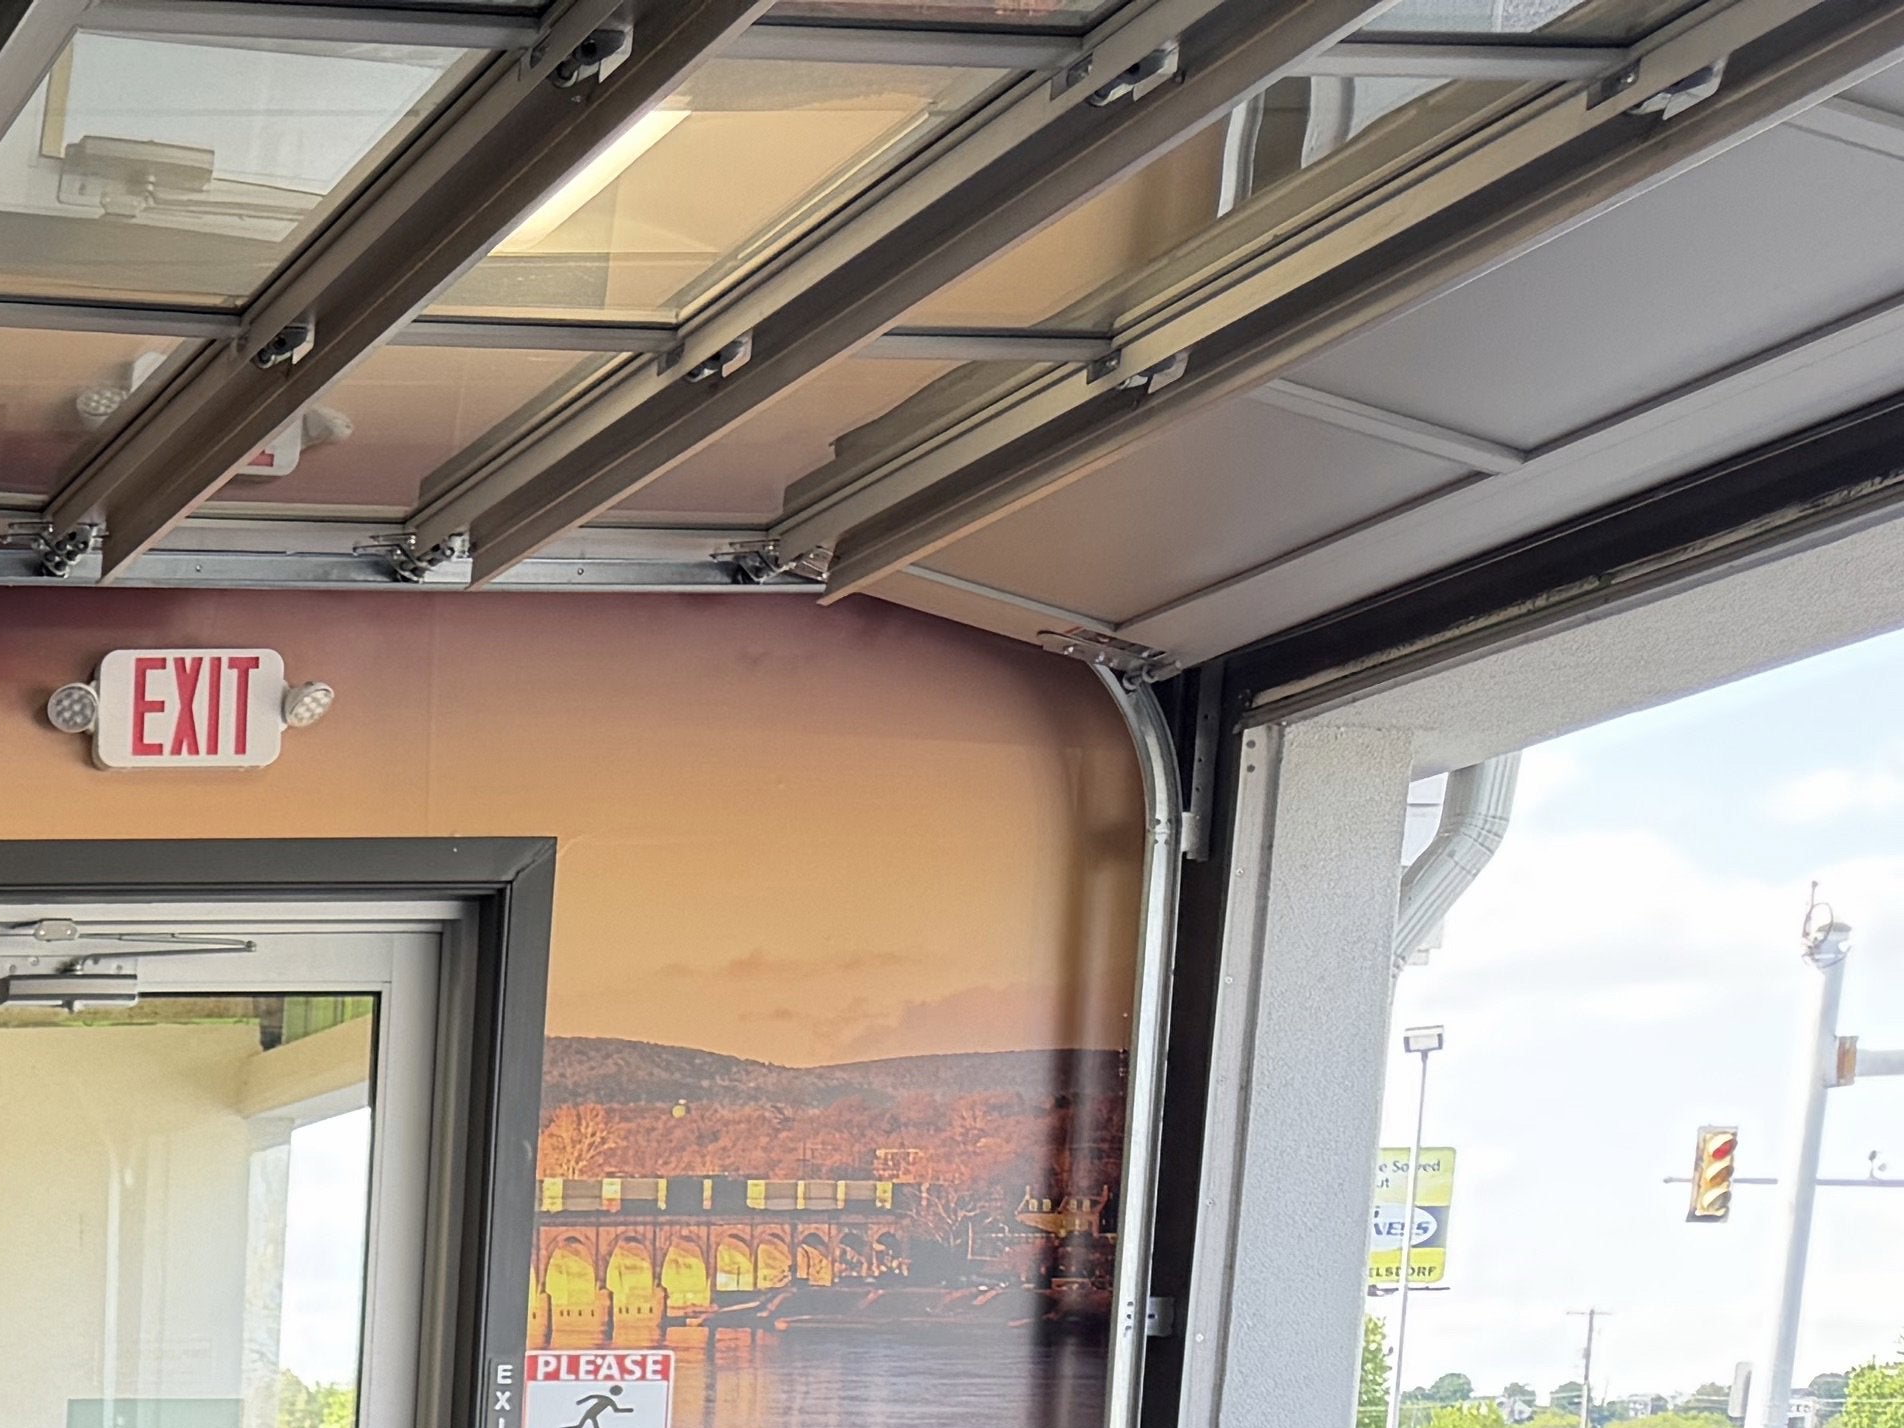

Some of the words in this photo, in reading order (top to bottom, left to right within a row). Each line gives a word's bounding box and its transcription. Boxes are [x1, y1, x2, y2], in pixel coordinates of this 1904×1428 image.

[131, 656, 260, 756] EXIT
[1392, 1159, 1441, 1173] Soved
[536, 1355, 663, 1381] PLEASE
